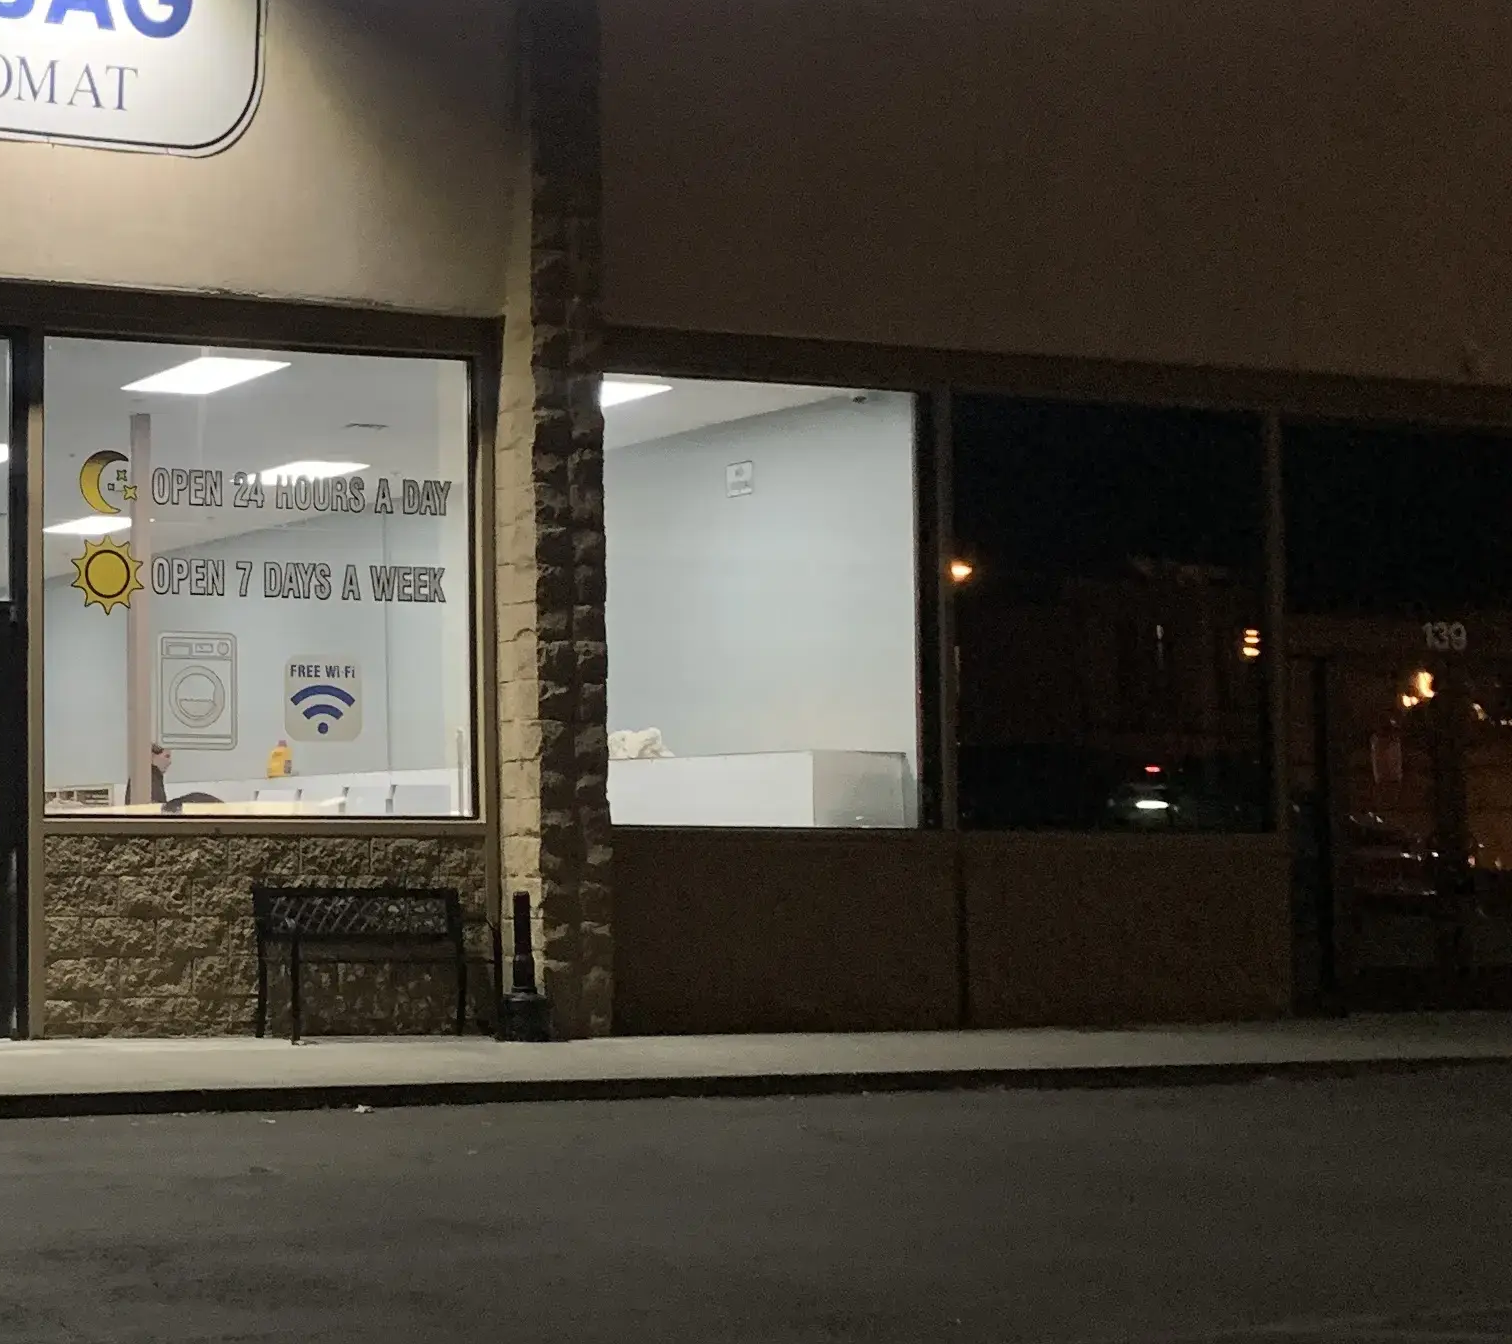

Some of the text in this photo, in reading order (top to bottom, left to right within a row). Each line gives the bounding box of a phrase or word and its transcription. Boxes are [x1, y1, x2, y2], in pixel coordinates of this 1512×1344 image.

[151, 467, 452, 516] OPEN 24 HOURS A DAY
[151, 557, 447, 603] OPEN 7 DAYS A WEEK
[1421, 621, 1467, 652] 139
[290, 664, 321, 678] FREE
